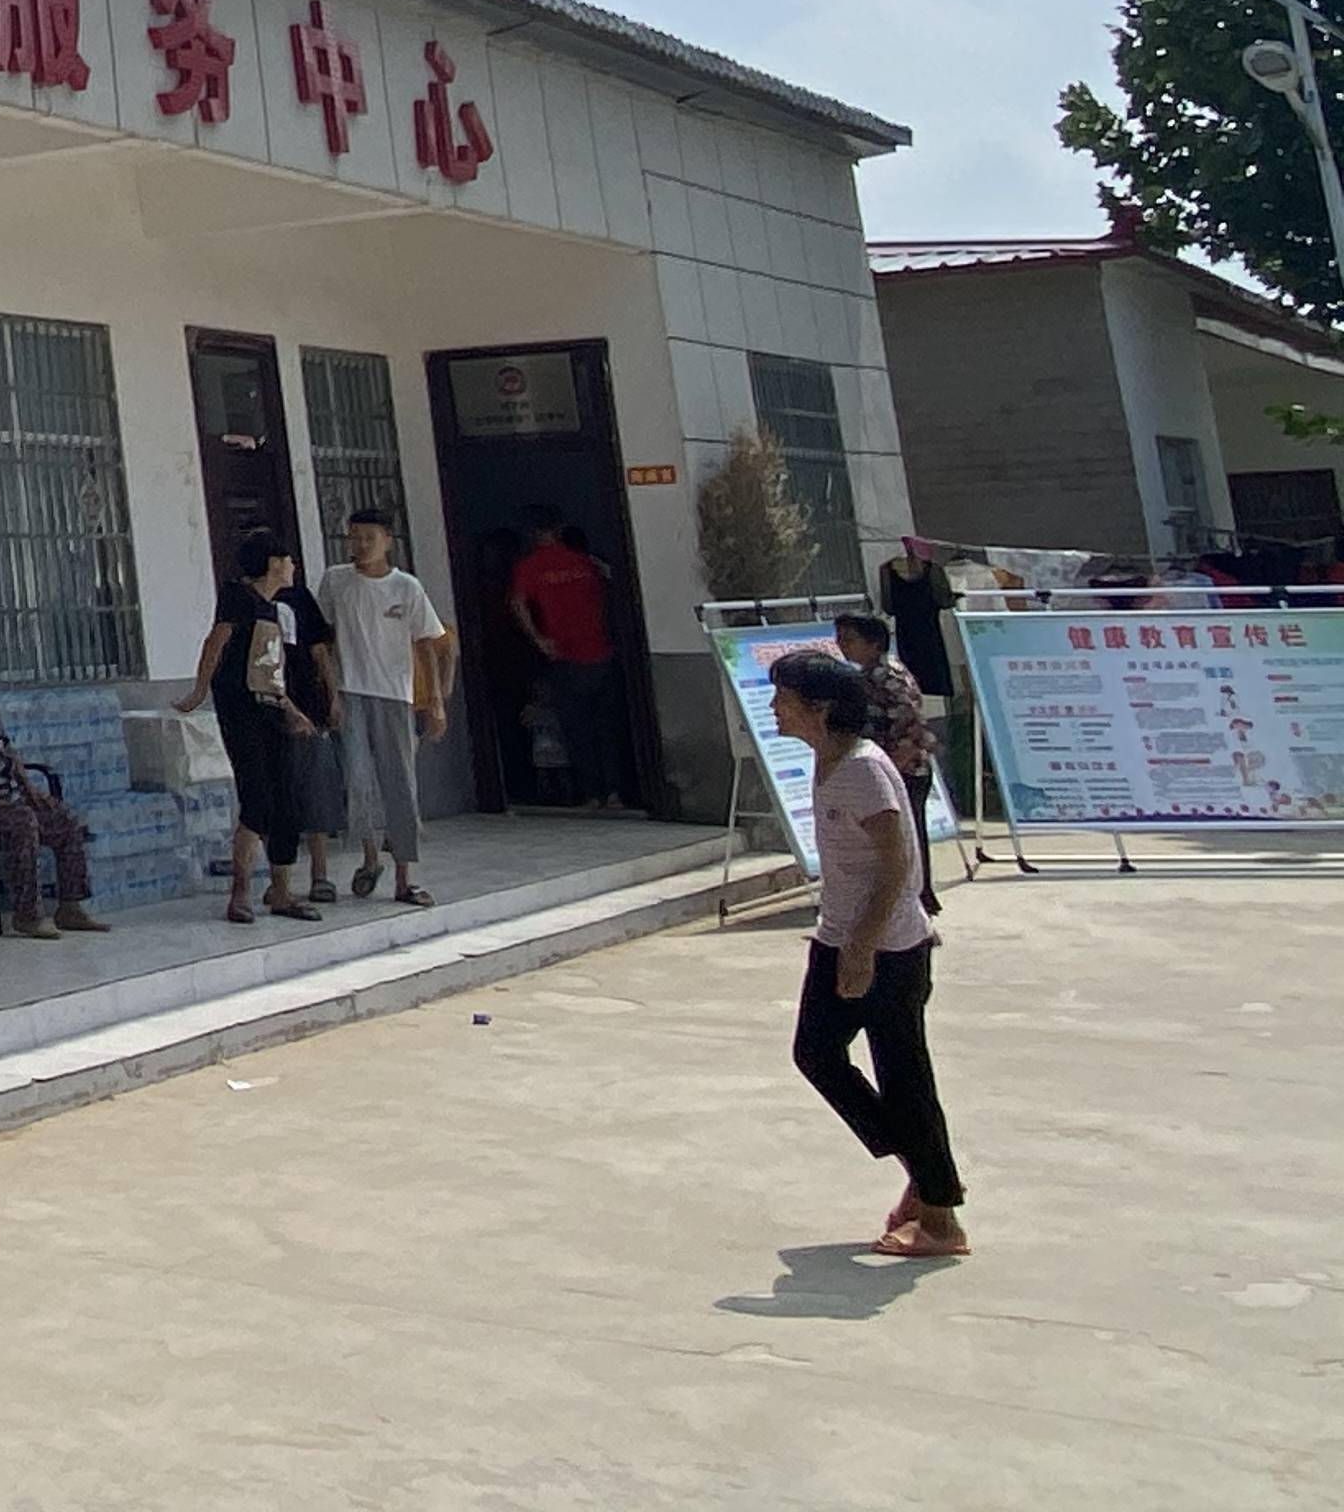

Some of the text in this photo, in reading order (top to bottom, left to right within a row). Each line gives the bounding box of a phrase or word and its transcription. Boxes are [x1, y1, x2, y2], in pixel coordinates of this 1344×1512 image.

[1068, 623, 1307, 650] 健康教育宣传栏
